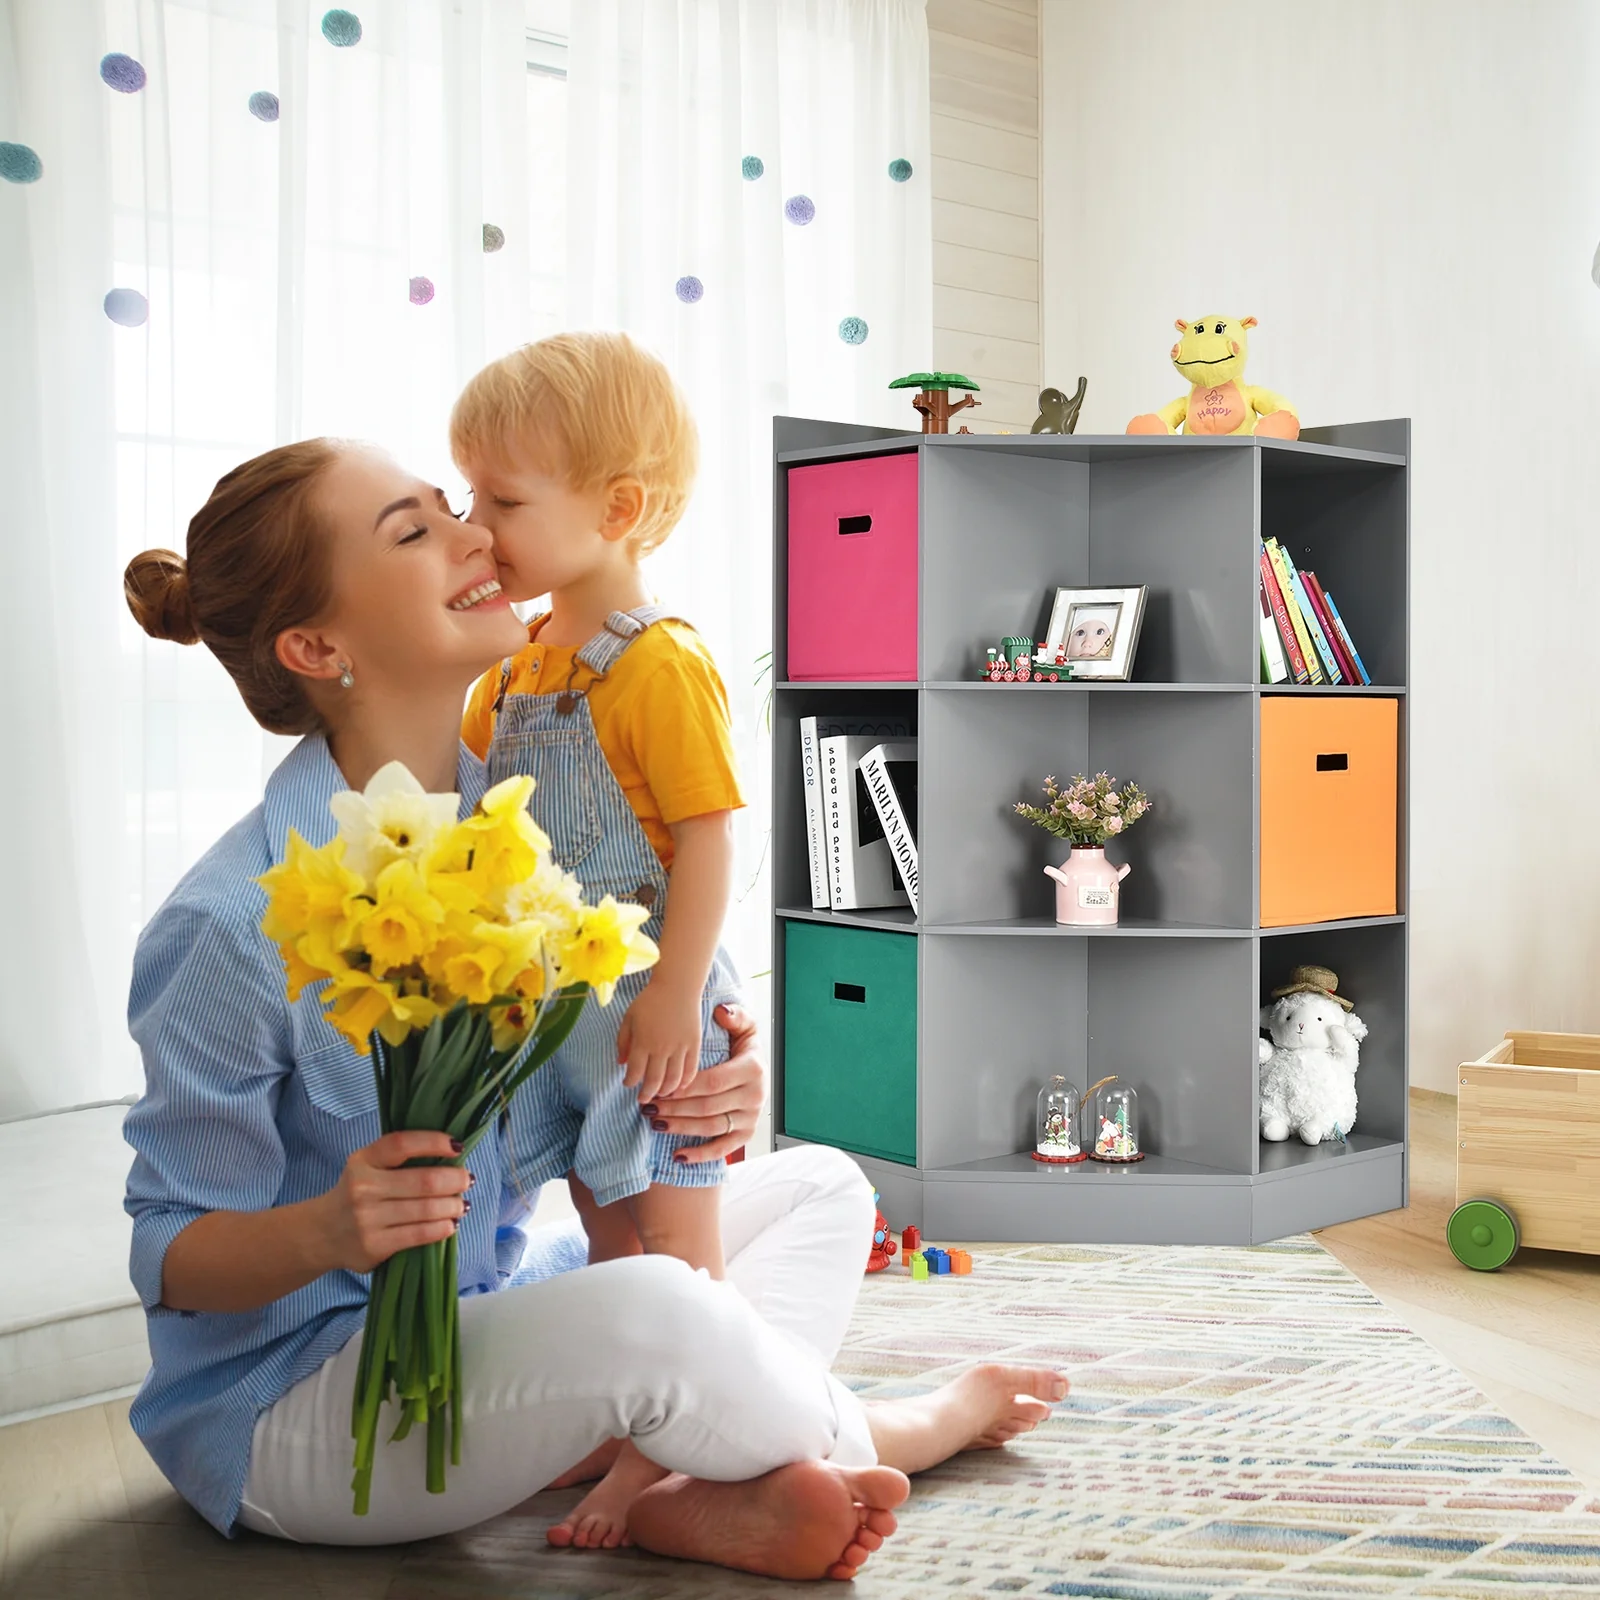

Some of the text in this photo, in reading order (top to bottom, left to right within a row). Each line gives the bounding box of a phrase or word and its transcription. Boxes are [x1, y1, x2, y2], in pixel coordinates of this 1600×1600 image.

[1197, 408, 1231, 419] Happy
[1275, 605, 1297, 651] garden
[804, 737, 814, 786] DECOR
[829, 747, 837, 794] speed
[834, 836, 842, 904] passion
[866, 760, 918, 901] MARILYN MONRO
